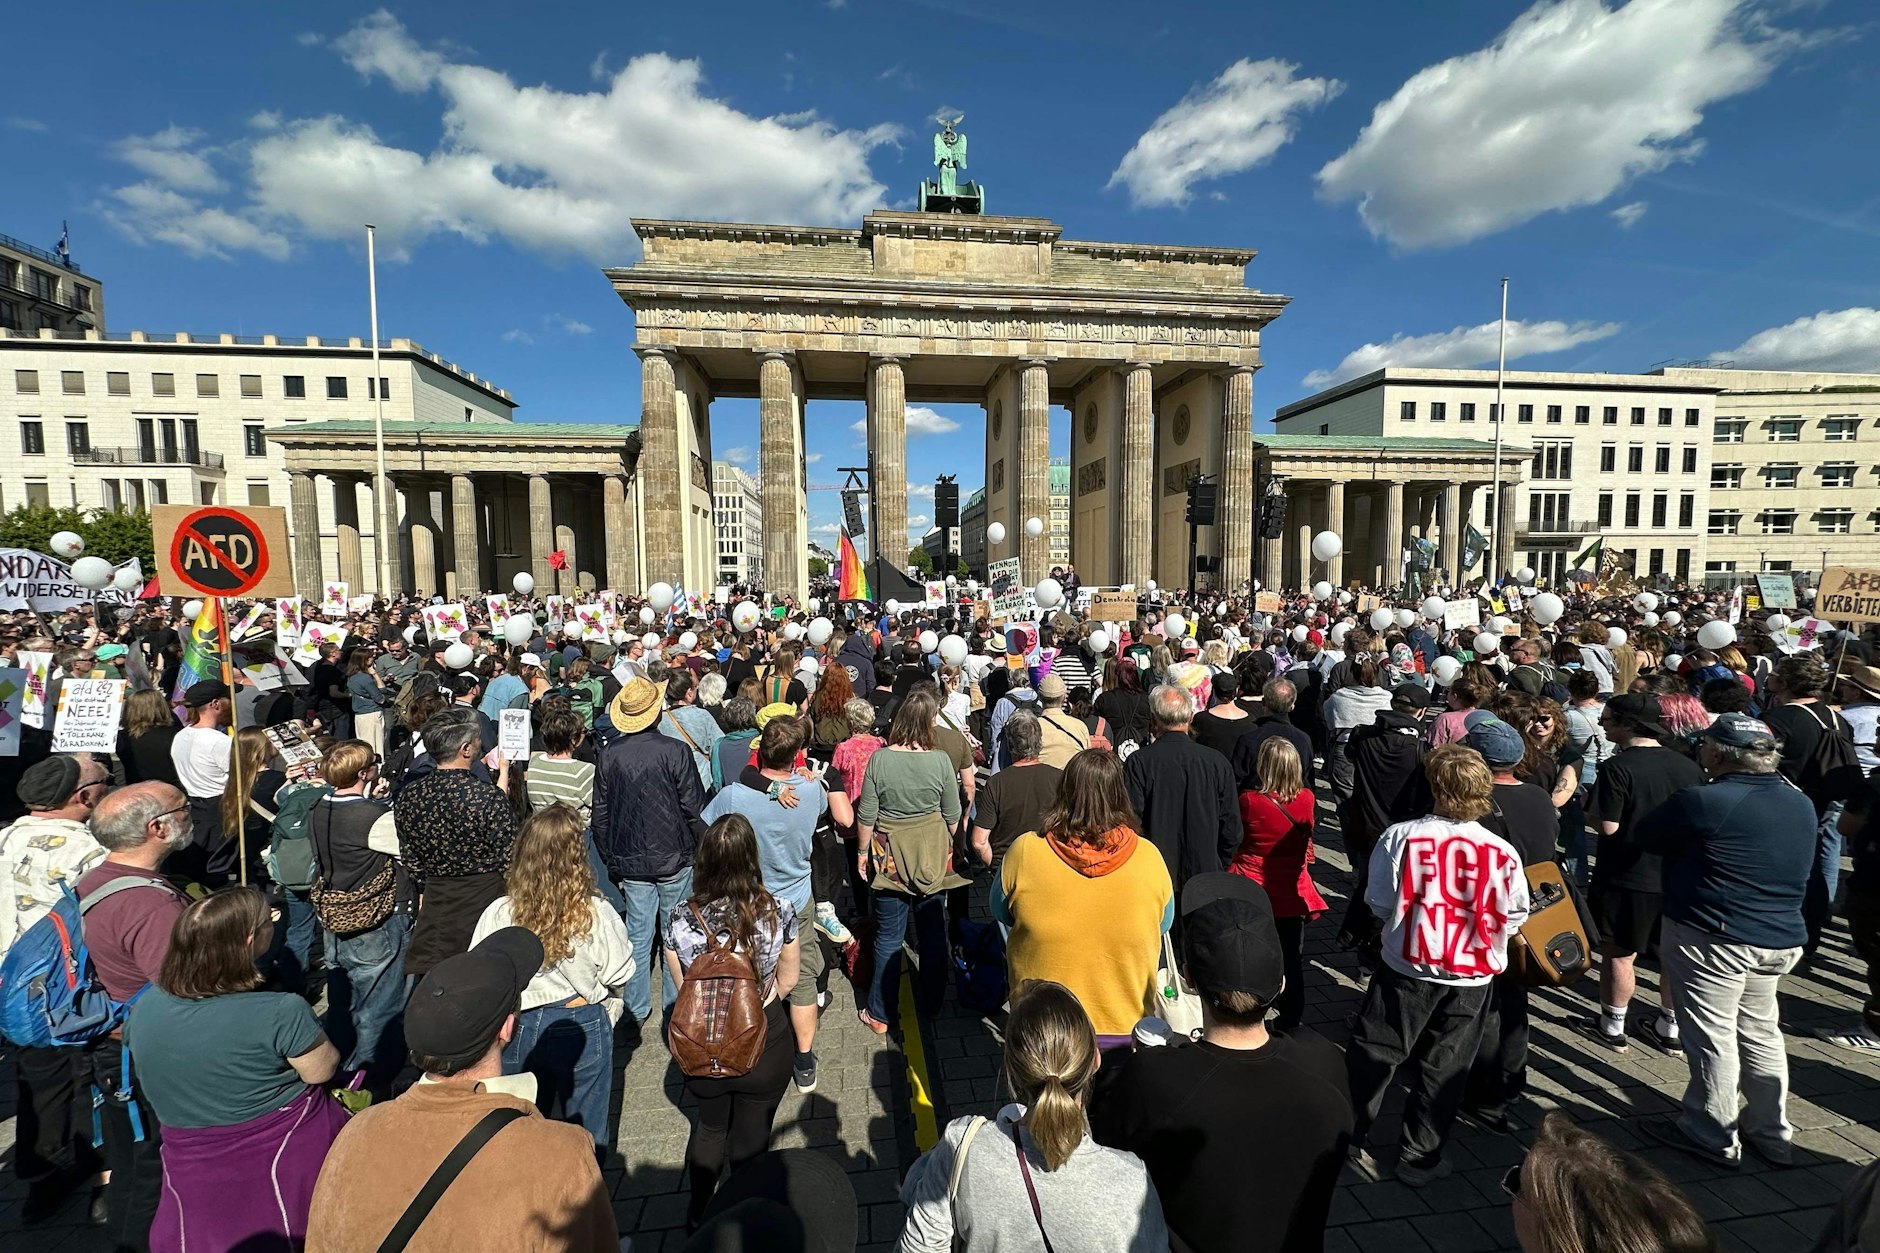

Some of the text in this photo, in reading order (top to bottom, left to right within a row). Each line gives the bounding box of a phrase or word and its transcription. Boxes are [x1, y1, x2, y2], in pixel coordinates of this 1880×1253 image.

[184, 534, 253, 570] AFD
[992, 570, 1007, 579] AFD
[72, 680, 94, 696] afd
[67, 704, 111, 719] NEEE!
